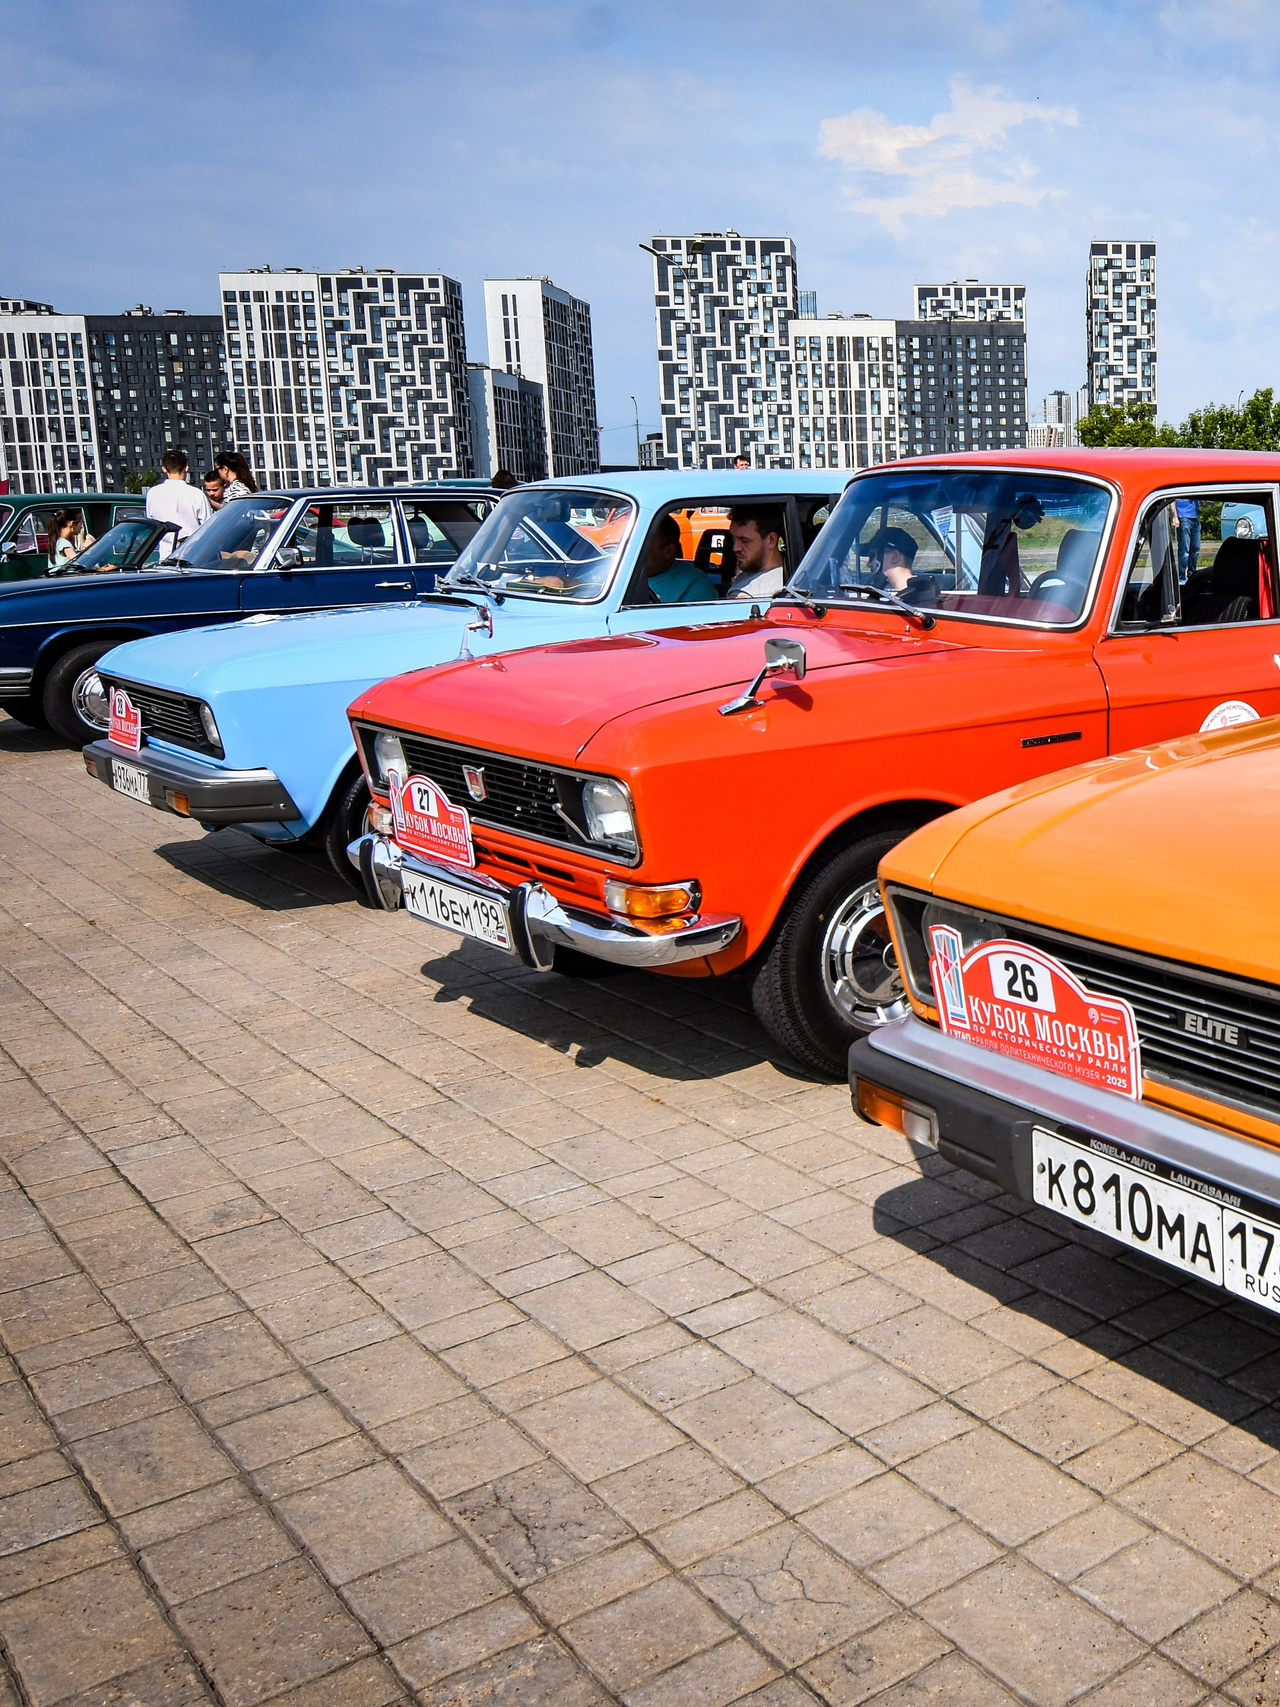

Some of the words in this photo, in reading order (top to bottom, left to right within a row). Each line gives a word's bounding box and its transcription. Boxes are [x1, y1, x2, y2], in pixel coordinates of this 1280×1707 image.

[418, 787, 430, 811] 27
[404, 810, 430, 833] КУБОК
[429, 818, 466, 845] МОСКВЫ
[408, 882, 474, 931] К116ЕМ
[473, 900, 499, 930] 199
[483, 927, 497, 939] RUS
[1004, 959, 1039, 1003] 26
[968, 995, 1031, 1038] КУБОК
[1033, 1012, 1126, 1063] МОСКВЫ
[973, 1024, 986, 1035] ПО
[991, 1029, 1082, 1062] ИСТОРИЧЕСКОМУ
[1087, 1057, 1127, 1075] РАЛЛИ
[1184, 1012, 1239, 1046] ELITE
[975, 1036, 999, 1051] РАЛЛИ
[1000, 1043, 1073, 1073] ПОЛИТЕХНИЧЕСКОГО
[1075, 1066, 1100, 1081] МУЗЕЯ
[1106, 1075, 1127, 1088] 2025
[1090, 1138, 1156, 1173] KONELA-AUTO
[1170, 1171, 1242, 1208] LAUTTASAARI
[1048, 1157, 1216, 1273] К810МА
